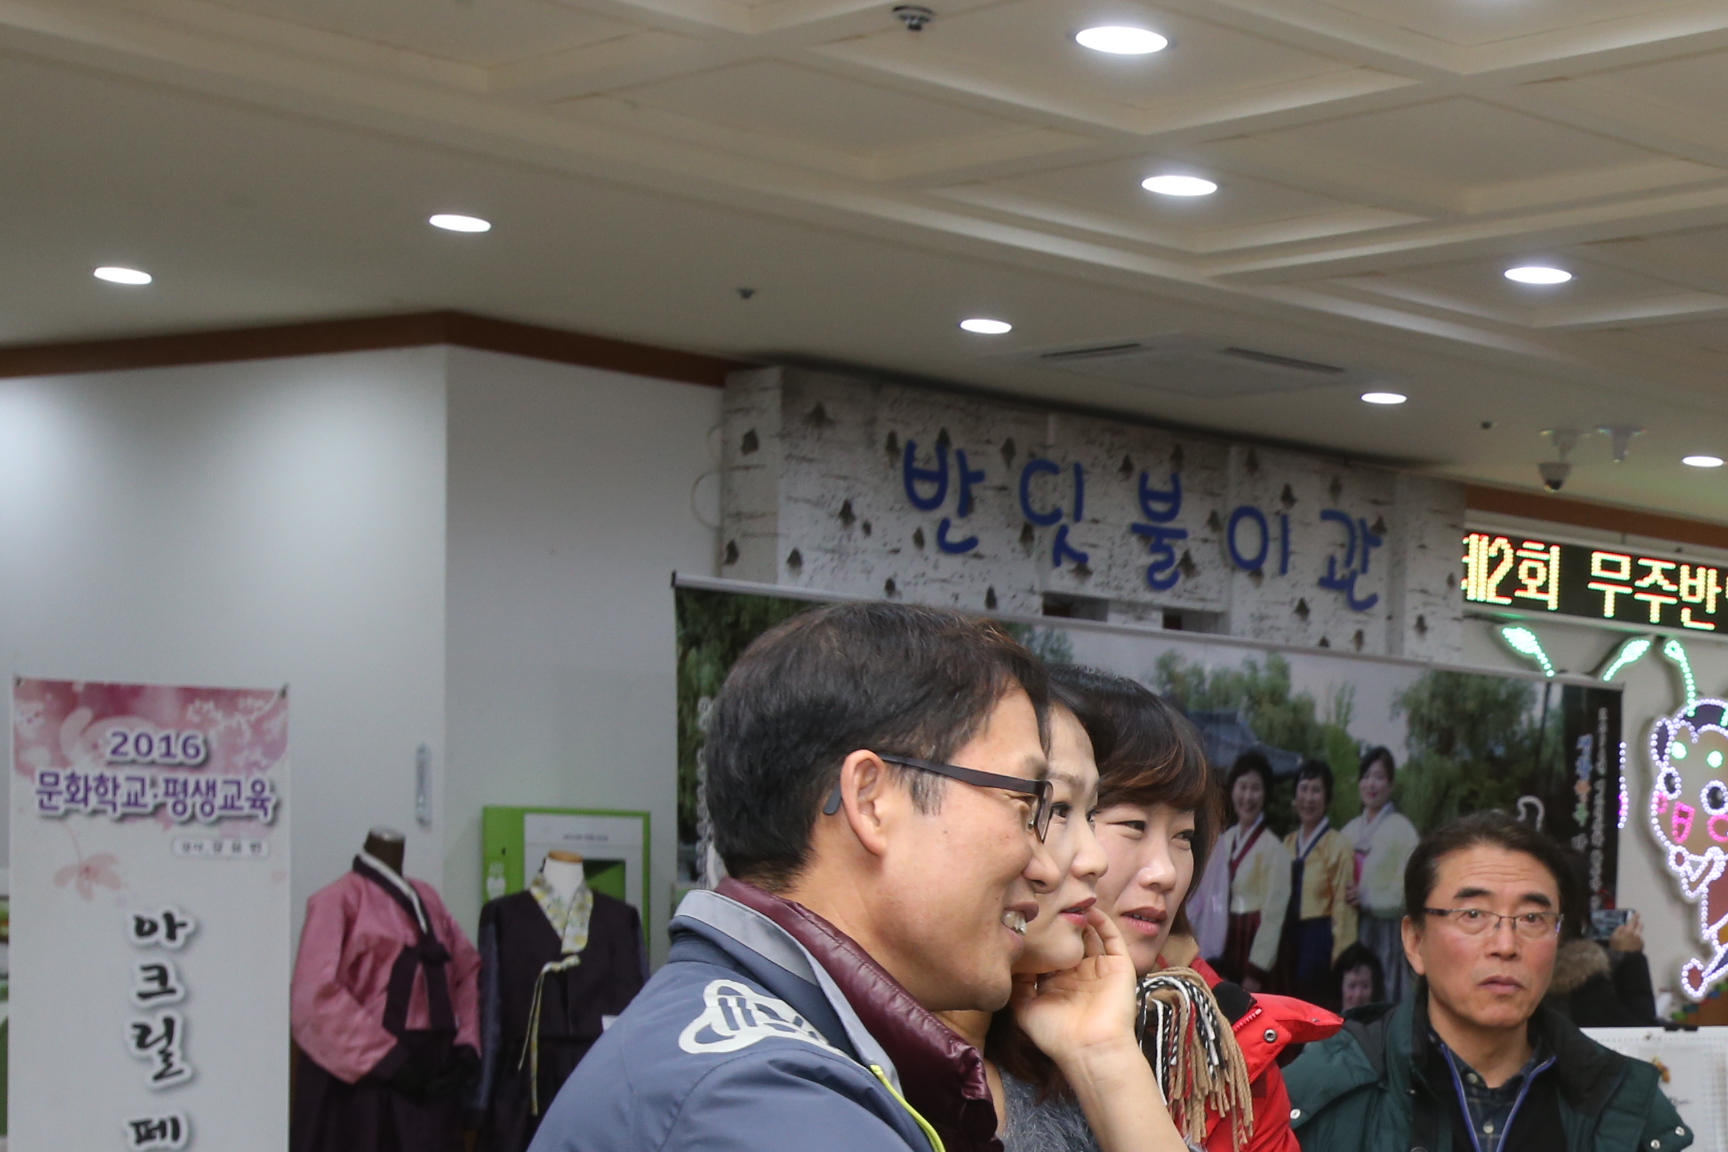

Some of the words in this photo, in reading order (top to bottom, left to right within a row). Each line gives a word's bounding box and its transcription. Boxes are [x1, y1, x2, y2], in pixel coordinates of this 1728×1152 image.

[904, 439, 1383, 611] 반딧불이관
[111, 731, 202, 760] 2016
[130, 911, 188, 1083] 아크릴
